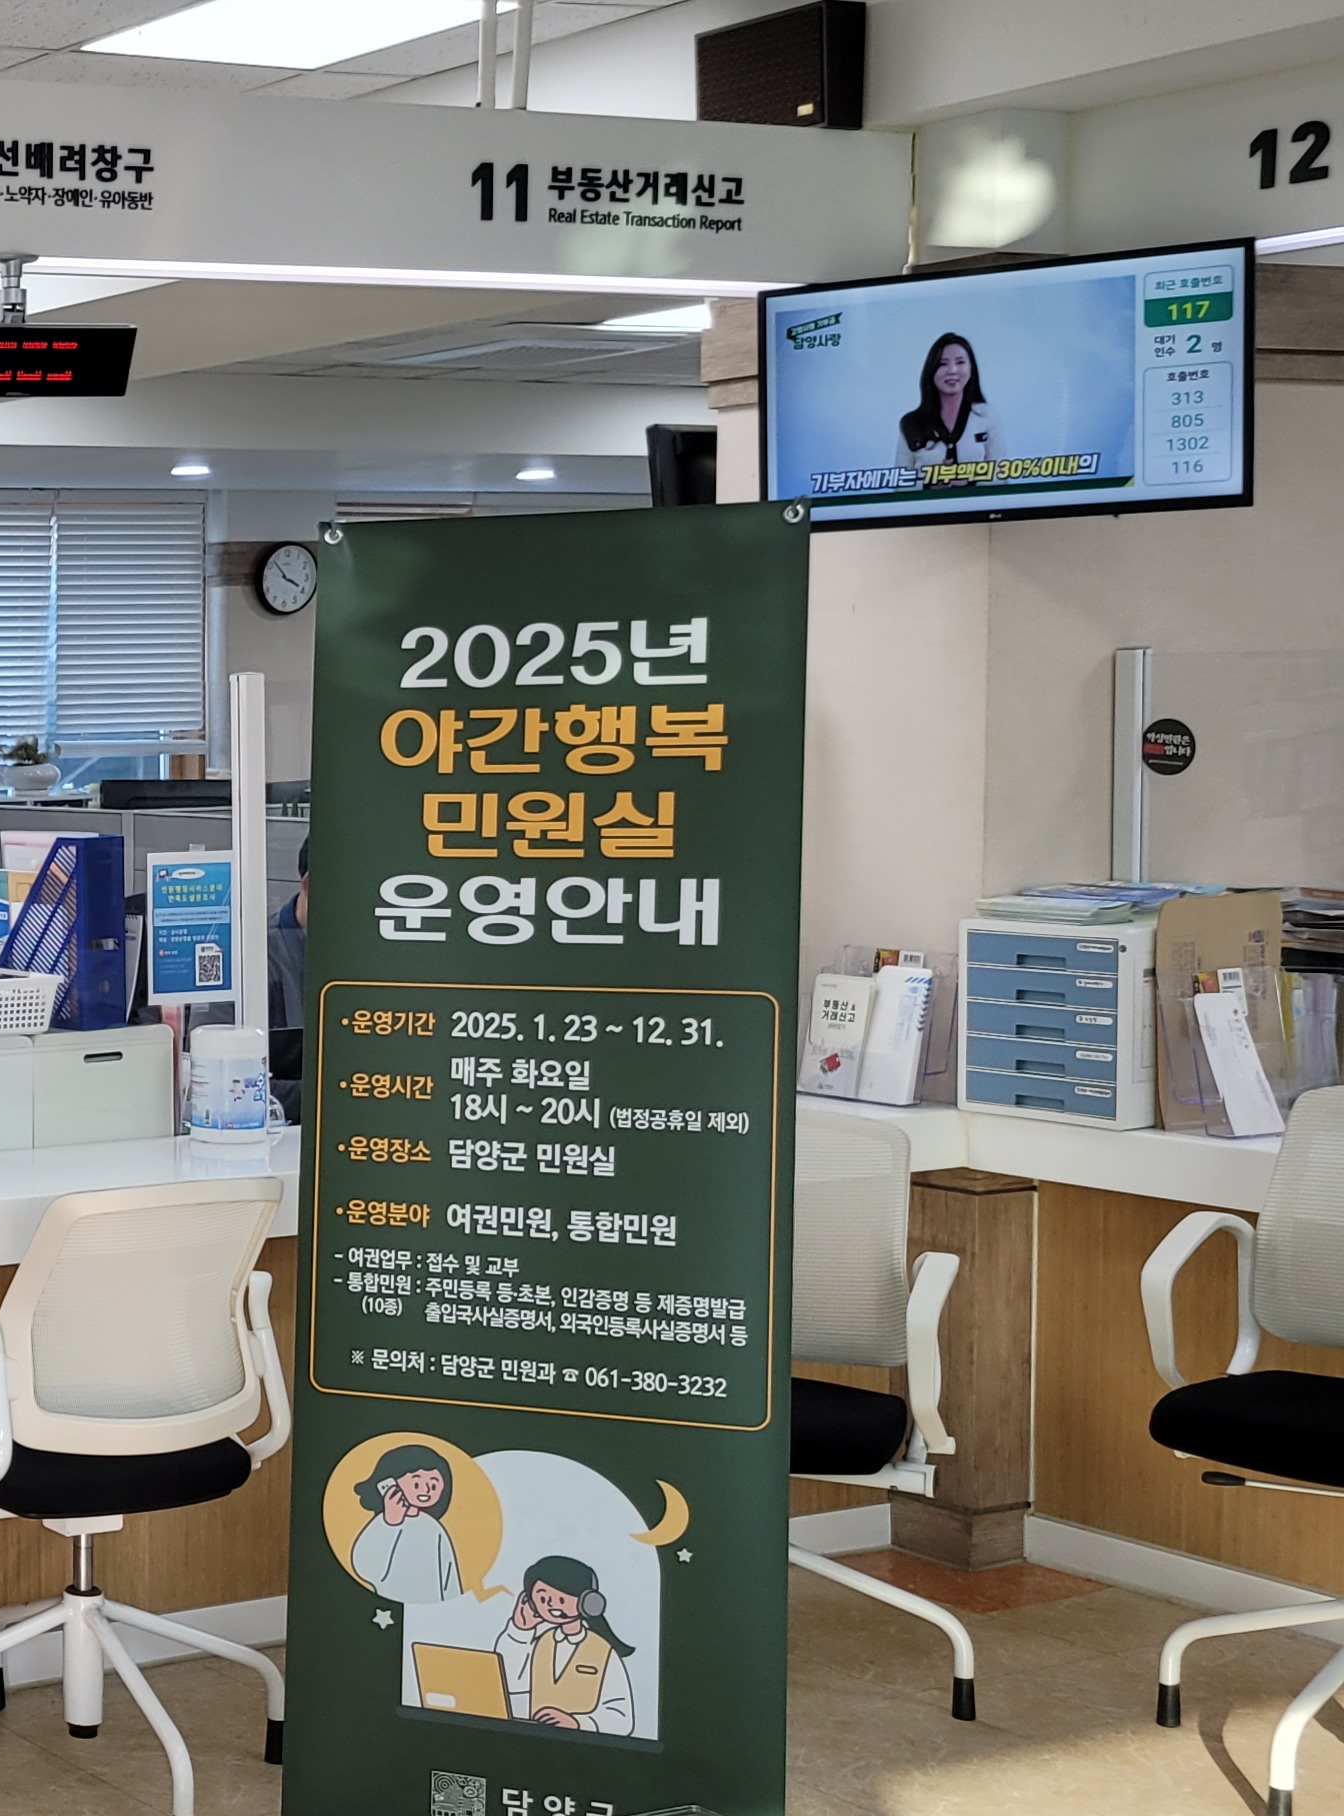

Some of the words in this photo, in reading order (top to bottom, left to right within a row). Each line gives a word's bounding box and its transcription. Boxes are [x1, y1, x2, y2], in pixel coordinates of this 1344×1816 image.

[1249, 120, 1331, 189] 12
[470, 161, 529, 222] 11
[547, 165, 745, 207] 부동산거래신고
[548, 208, 577, 224] Real
[580, 210, 620, 225] Estate
[623, 211, 696, 229] Transaction
[699, 215, 743, 233] Report
[1154, 278, 1176, 291] 최근
[1180, 273, 1224, 289] 호출번호
[1167, 300, 1210, 321] 117
[793, 333, 841, 350] 담양사랑
[1154, 334, 1176, 346] 대기
[1154, 346, 1176, 358] 인수
[1185, 334, 1203, 354] 2
[1211, 341, 1223, 353] 명
[1166, 368, 1210, 382] 호출번호
[1170, 390, 1204, 405] 313
[1170, 413, 1204, 428] 805
[1165, 436, 1209, 451] 1302
[811, 466, 916, 493] 기부자에게는
[920, 460, 993, 484] 기부액의
[996, 453, 1100, 479] 30%이내의
[1171, 460, 1204, 474] 116
[400, 617, 709, 689] 2025년
[380, 704, 729, 775] 야간행복
[422, 791, 676, 859] 민원실
[374, 874, 721, 946] 운영안내
[351, 1010, 436, 1038] 운영기간
[450, 1011, 525, 1042] 2025.
[532, 1013, 556, 1043] 1.
[563, 1015, 598, 1043] 23
[632, 1017, 673, 1047] 12.
[680, 1018, 725, 1049] 31.
[821, 1010, 856, 1022] 거래신고
[450, 1057, 503, 1088] 매주
[510, 1059, 591, 1091] 화요일
[349, 1073, 435, 1100] 운영시간
[450, 1094, 508, 1125] 18시
[540, 1097, 601, 1129] 20시
[609, 1106, 703, 1132] (법정공휴일
[708, 1110, 750, 1135] 제외)
[348, 1136, 432, 1164] 운영장소
[448, 1139, 528, 1173] 담양군
[536, 1143, 616, 1177] 민원실
[346, 1200, 431, 1228] 운영분야
[445, 1203, 559, 1242] 여권민원,
[566, 1210, 678, 1247] 통합민원
[348, 1247, 412, 1271] 여권업무
[426, 1252, 460, 1274] 접수
[465, 1255, 481, 1276] 및
[485, 1257, 520, 1278] 교부
[347, 1272, 412, 1295] 통합민원
[425, 1277, 492, 1302] 주민등록
[560, 1287, 629, 1313] 인감증명
[634, 1292, 652, 1313] 등
[656, 1293, 747, 1320] 제증명발급
[361, 1296, 403, 1317] (10종)
[424, 1301, 556, 1332] 출입국사실증명서,
[559, 1312, 725, 1345] 외국인등록사실증명서
[729, 1324, 749, 1347] 등
[371, 1348, 426, 1373] 문의처
[441, 1354, 495, 1380] 담양군
[500, 1359, 556, 1384] 민원과
[584, 1367, 728, 1398] 061-380-3232
